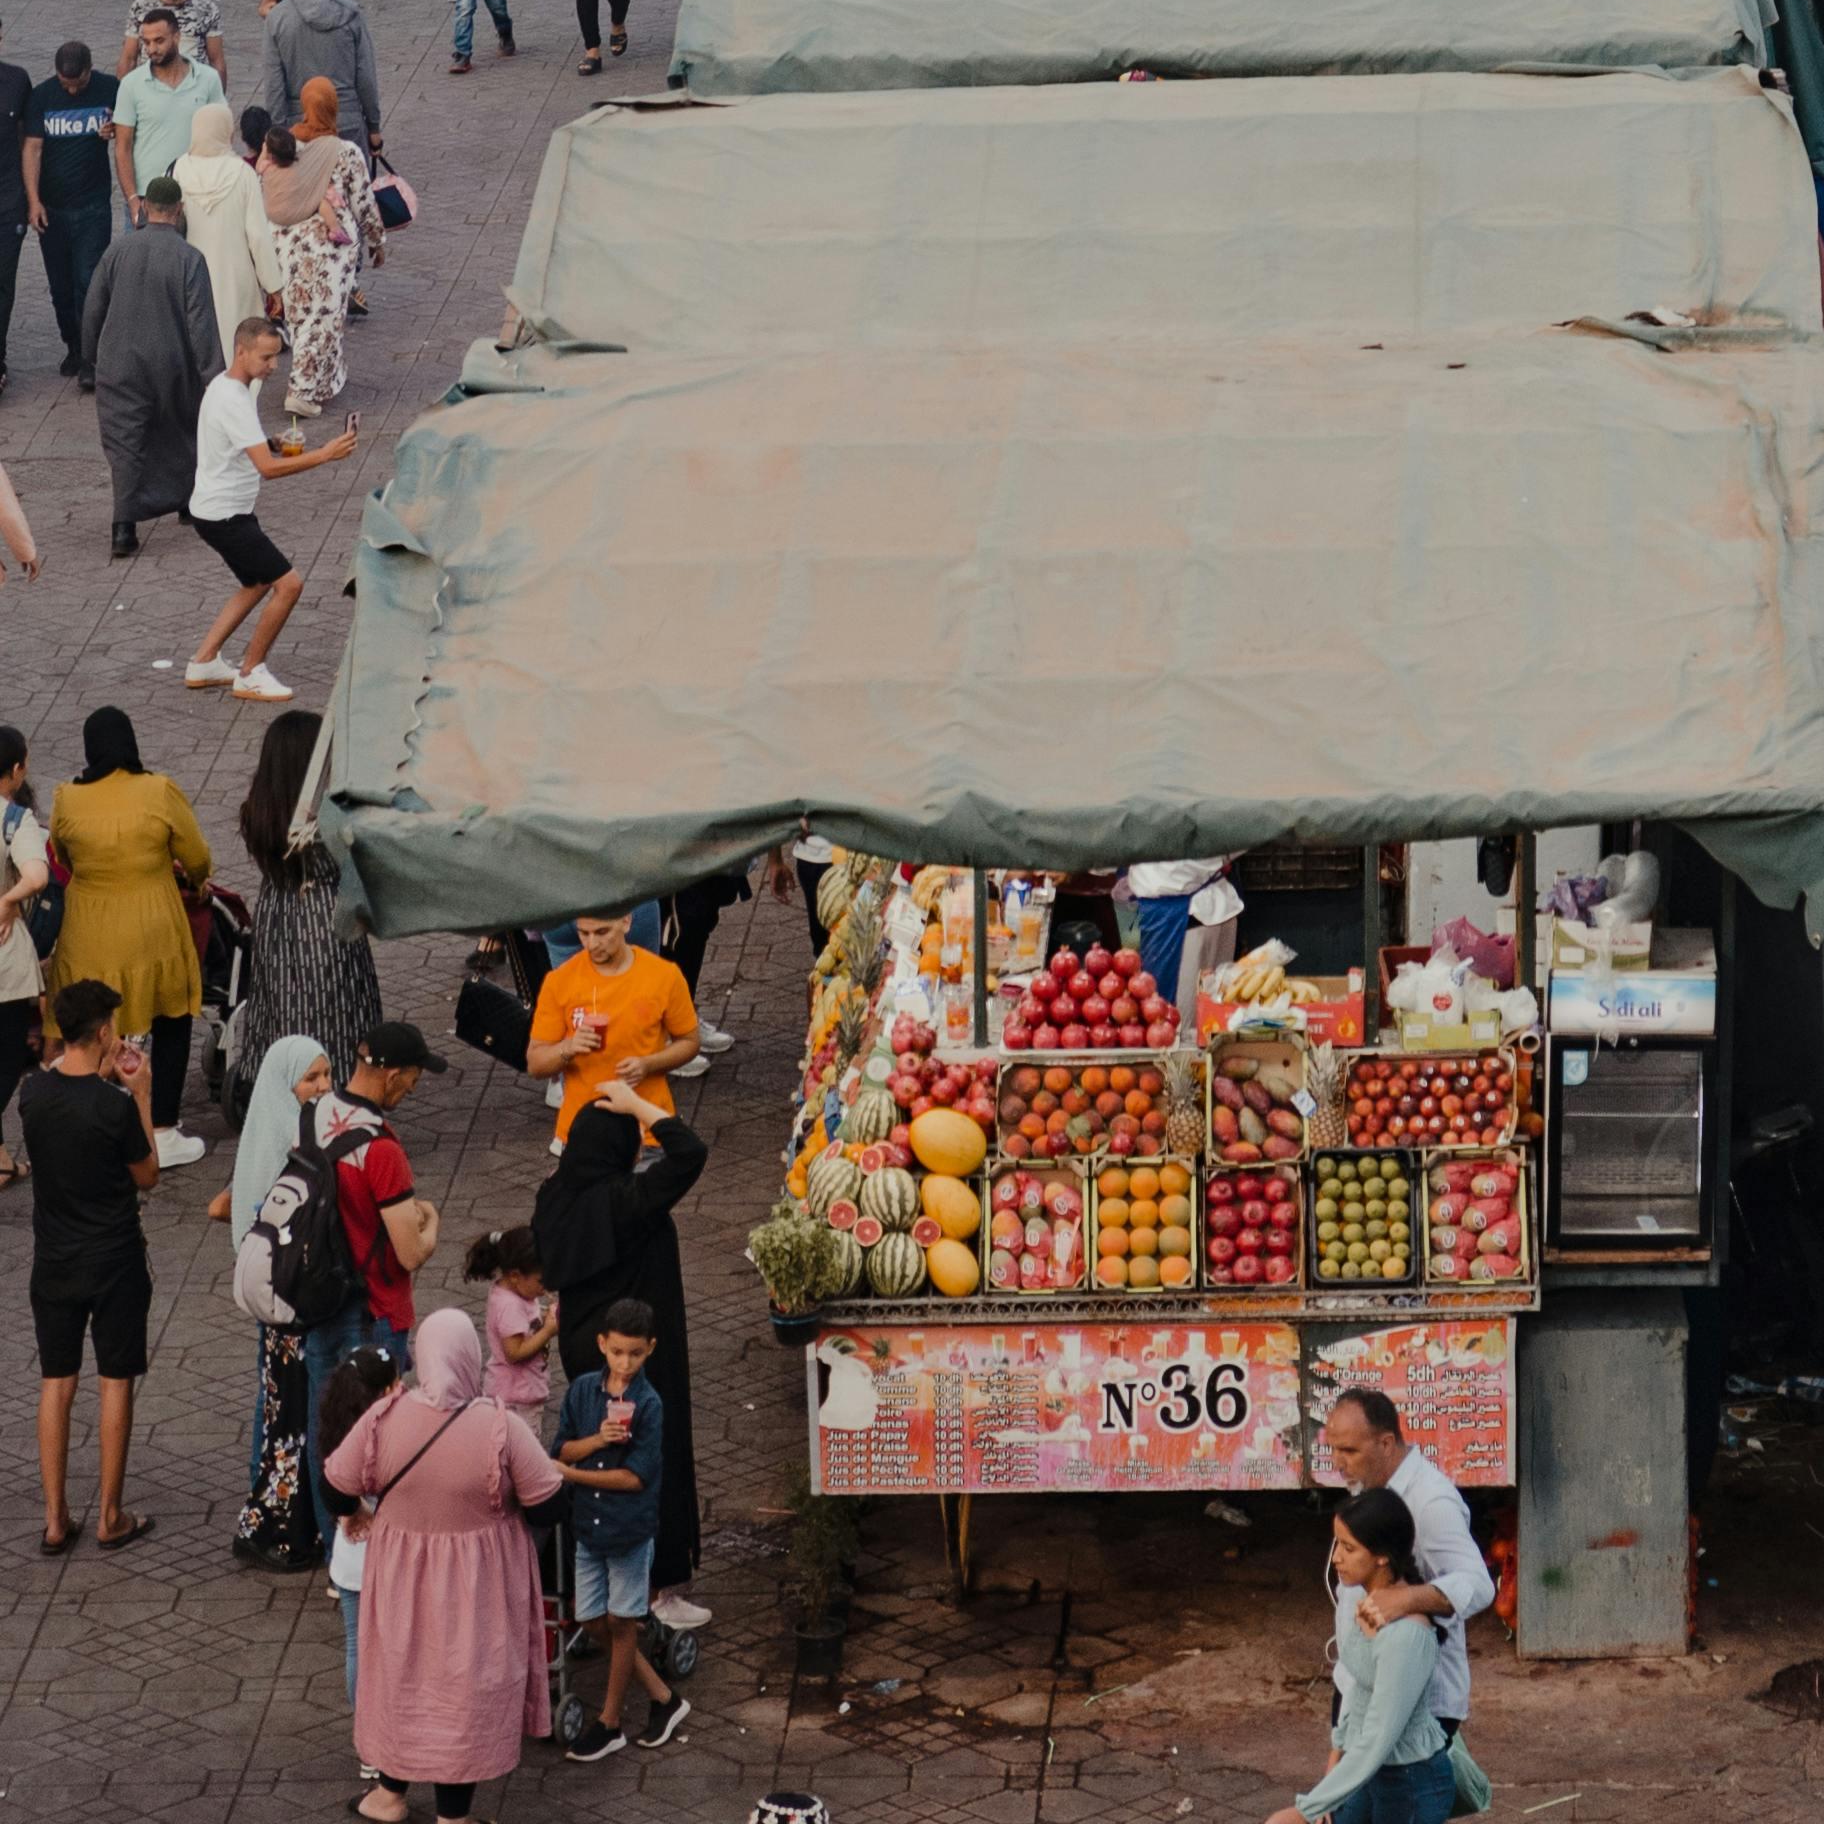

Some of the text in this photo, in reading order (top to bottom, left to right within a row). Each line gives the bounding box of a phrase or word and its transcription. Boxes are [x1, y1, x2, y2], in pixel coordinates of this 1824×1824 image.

[44, 117, 83, 136] Nike
[1638, 1000, 1662, 1018] ali
[872, 1373, 906, 1384] vocat
[1333, 1367, 1383, 1383] d'Orange
[1407, 1365, 1436, 1382] 5dh
[1407, 1385, 1420, 1397] 10
[1422, 1385, 1437, 1397] dh
[877, 1408, 904, 1418] oire
[1422, 1402, 1437, 1414] dh
[872, 1419, 910, 1430] nanas
[1407, 1418, 1437, 1429] 10 dh
[827, 1431, 849, 1441] Jus
[852, 1431, 868, 1441] de
[827, 1442, 849, 1452] Jus
[852, 1442, 868, 1452] de
[870, 1442, 910, 1452] Fraise
[1311, 1443, 1332, 1455] Eau
[827, 1454, 849, 1464] Jus
[852, 1454, 868, 1464] de
[871, 1454, 919, 1466] Mangue
[1311, 1459, 1333, 1472] Eau
[827, 1465, 849, 1475] Jus
[852, 1465, 868, 1475] de
[827, 1476, 849, 1487] Jus
[852, 1476, 868, 1487] de
